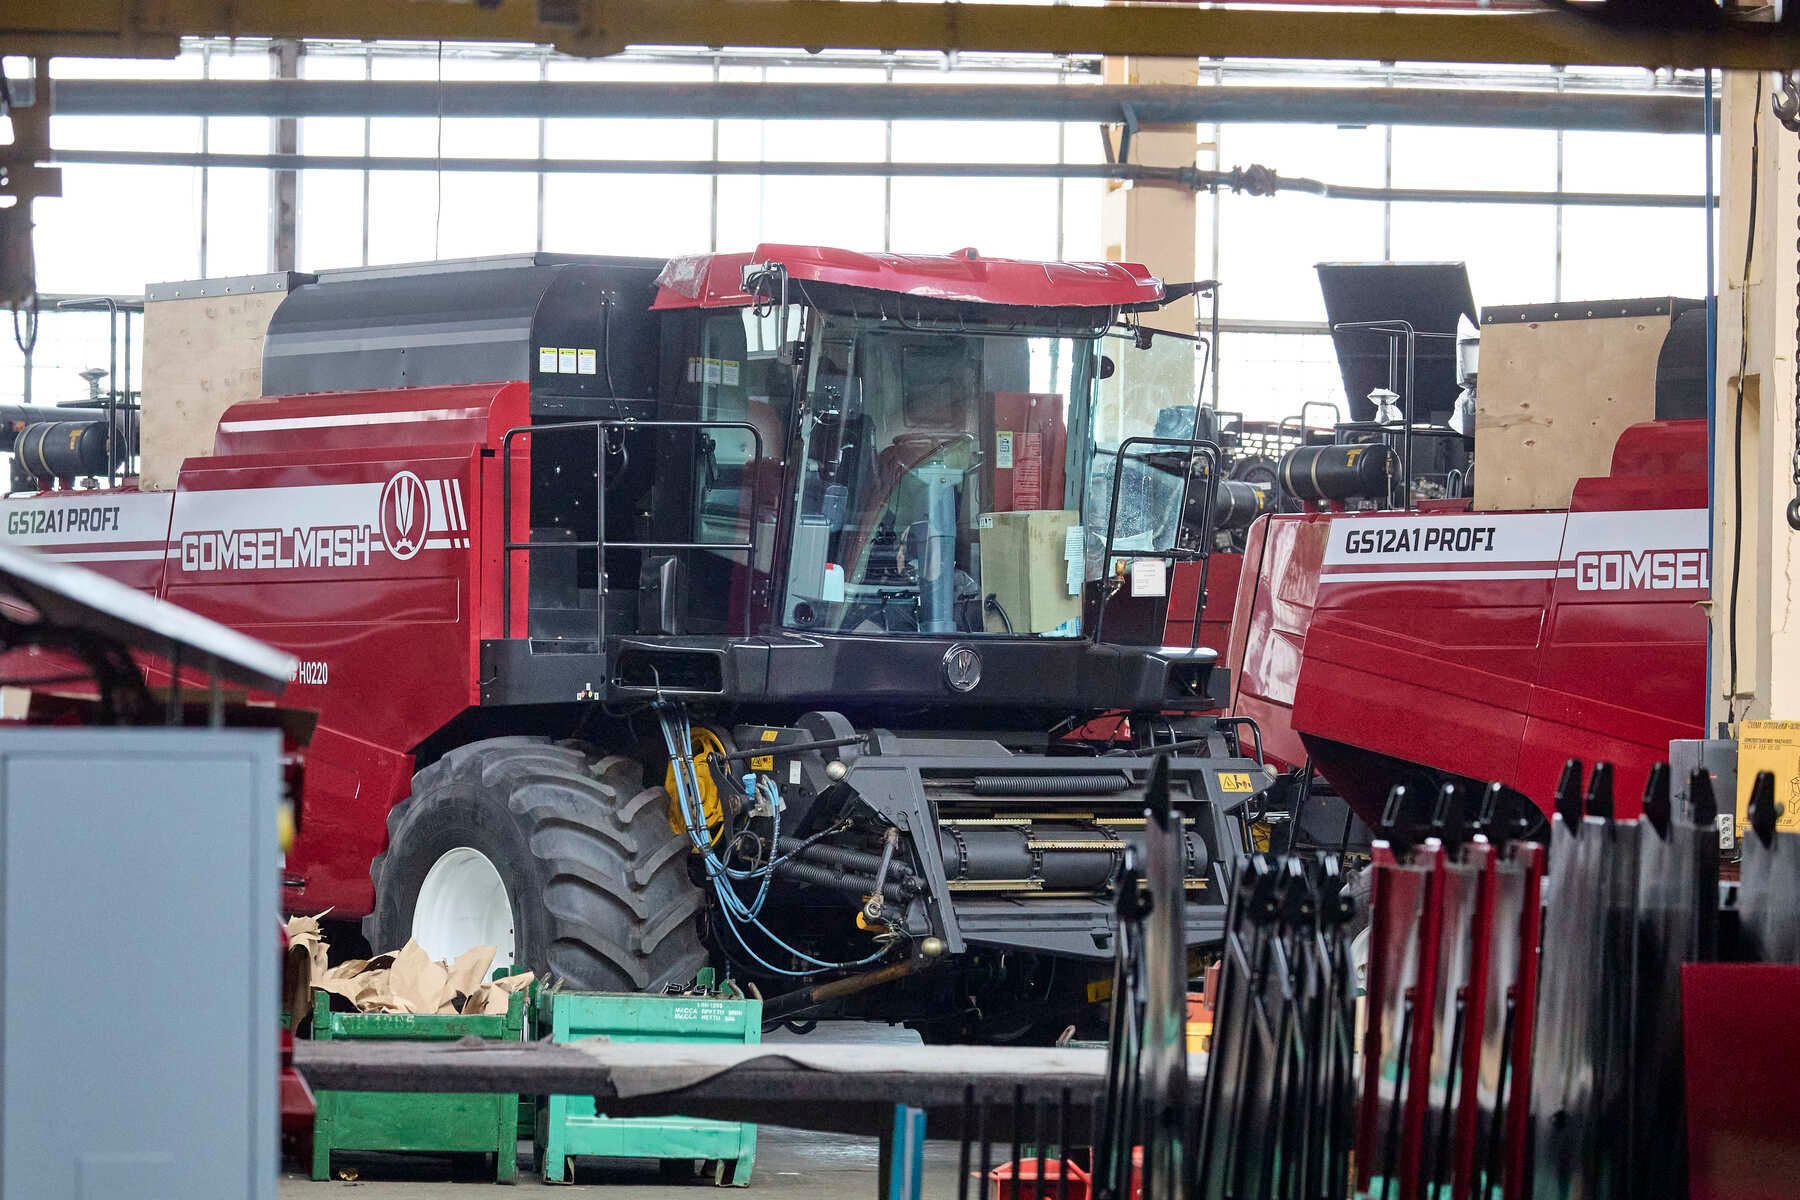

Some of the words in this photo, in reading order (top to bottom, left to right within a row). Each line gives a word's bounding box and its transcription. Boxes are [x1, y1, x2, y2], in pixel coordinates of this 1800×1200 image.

[8, 509, 64, 535] GS12A1
[66, 506, 120, 532] PROFI
[181, 528, 371, 572] GOMSELMASH
[1345, 528, 1421, 554] GS12A1
[1423, 527, 1496, 552] PROFI
[299, 661, 328, 685] H0220
